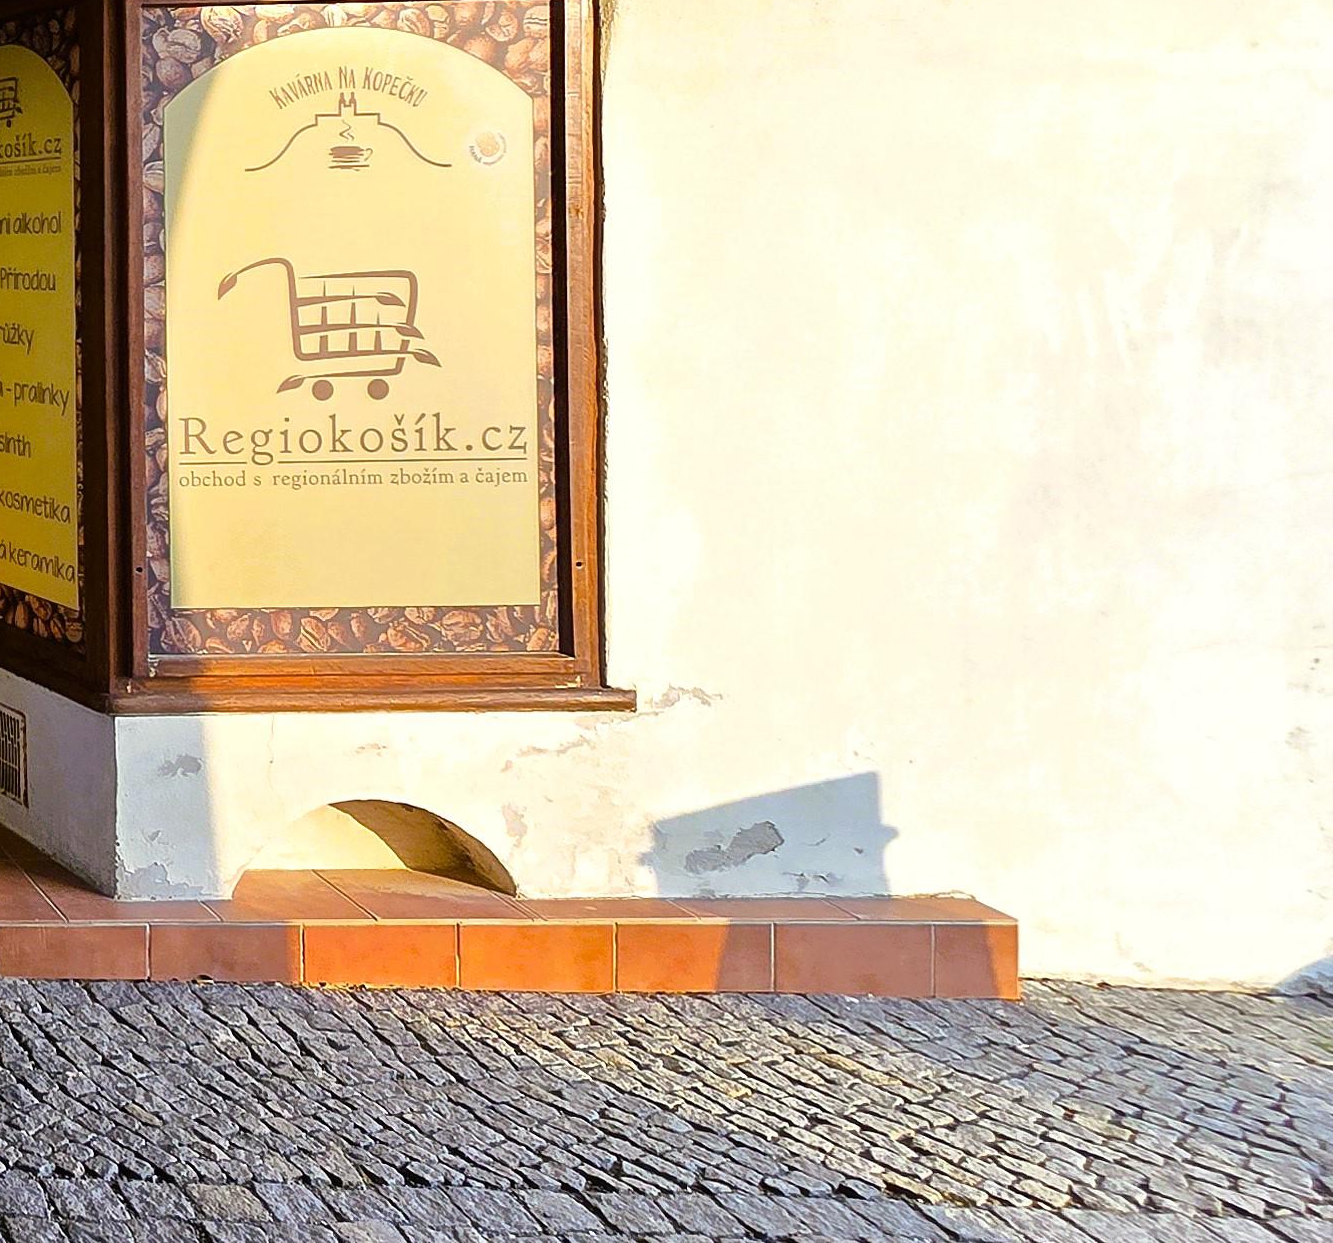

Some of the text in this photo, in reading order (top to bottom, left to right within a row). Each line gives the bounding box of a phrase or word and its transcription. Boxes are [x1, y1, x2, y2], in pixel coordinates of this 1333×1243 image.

[269, 66, 428, 109] KAVÁRNA NA KOPEČKU
[13, 211, 61, 234] alkohol
[0, 267, 56, 291] Přírodou
[14, 382, 69, 416] pralinky
[178, 412, 528, 465] Regiokošík.cz
[178, 467, 528, 490] obchod s regionálním zbožím a čajem
[9, 541, 75, 584] keramika
